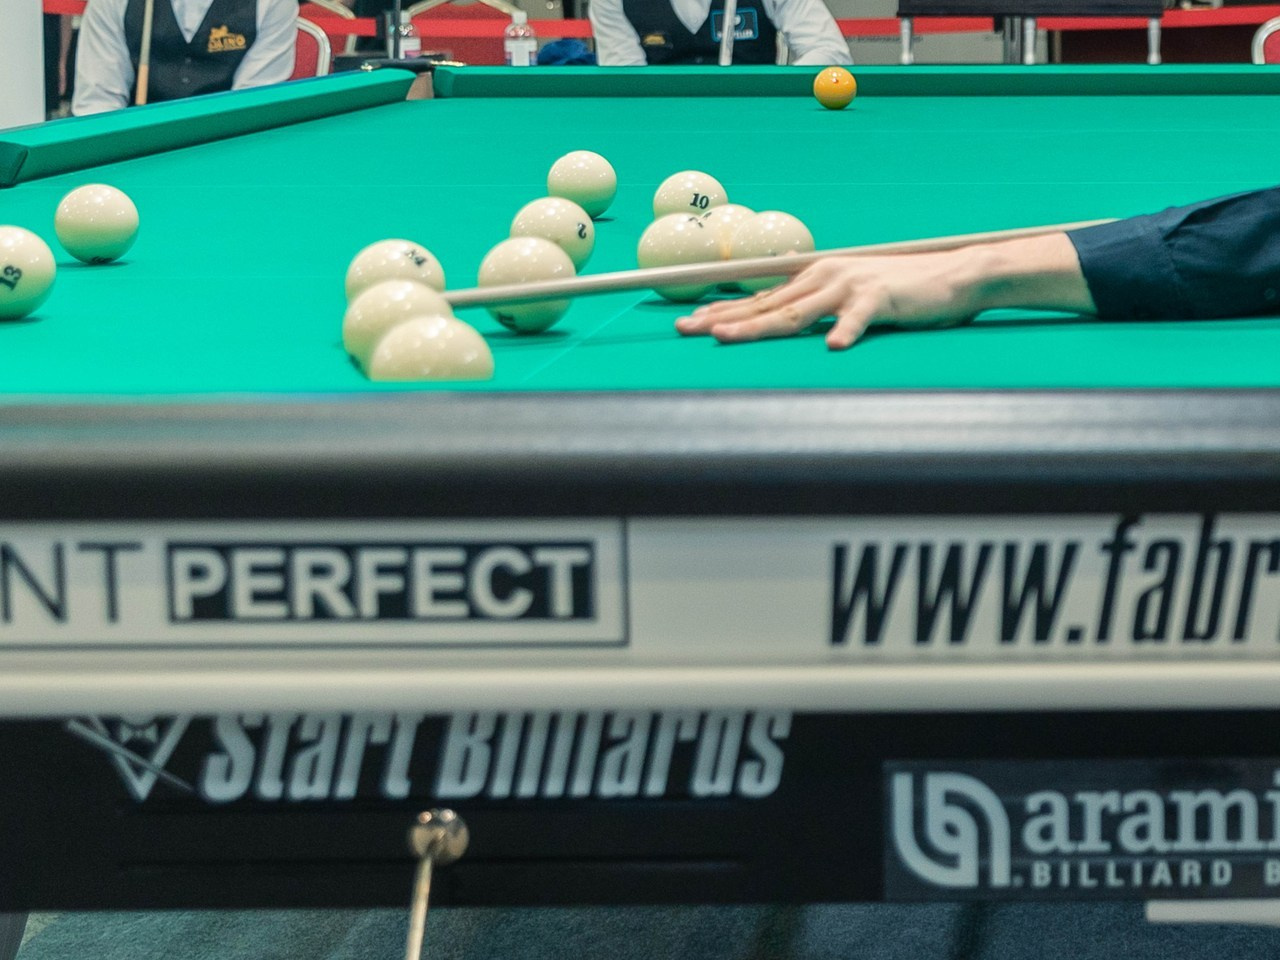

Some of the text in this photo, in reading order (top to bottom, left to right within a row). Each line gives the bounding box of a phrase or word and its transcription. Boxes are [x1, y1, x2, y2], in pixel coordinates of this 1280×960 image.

[689, 193, 709, 210] 10
[0, 264, 22, 291] 13
[172, 546, 591, 620] PERFECT
[202, 714, 424, 804] Start
[1033, 859, 1233, 886] BILLIARD
